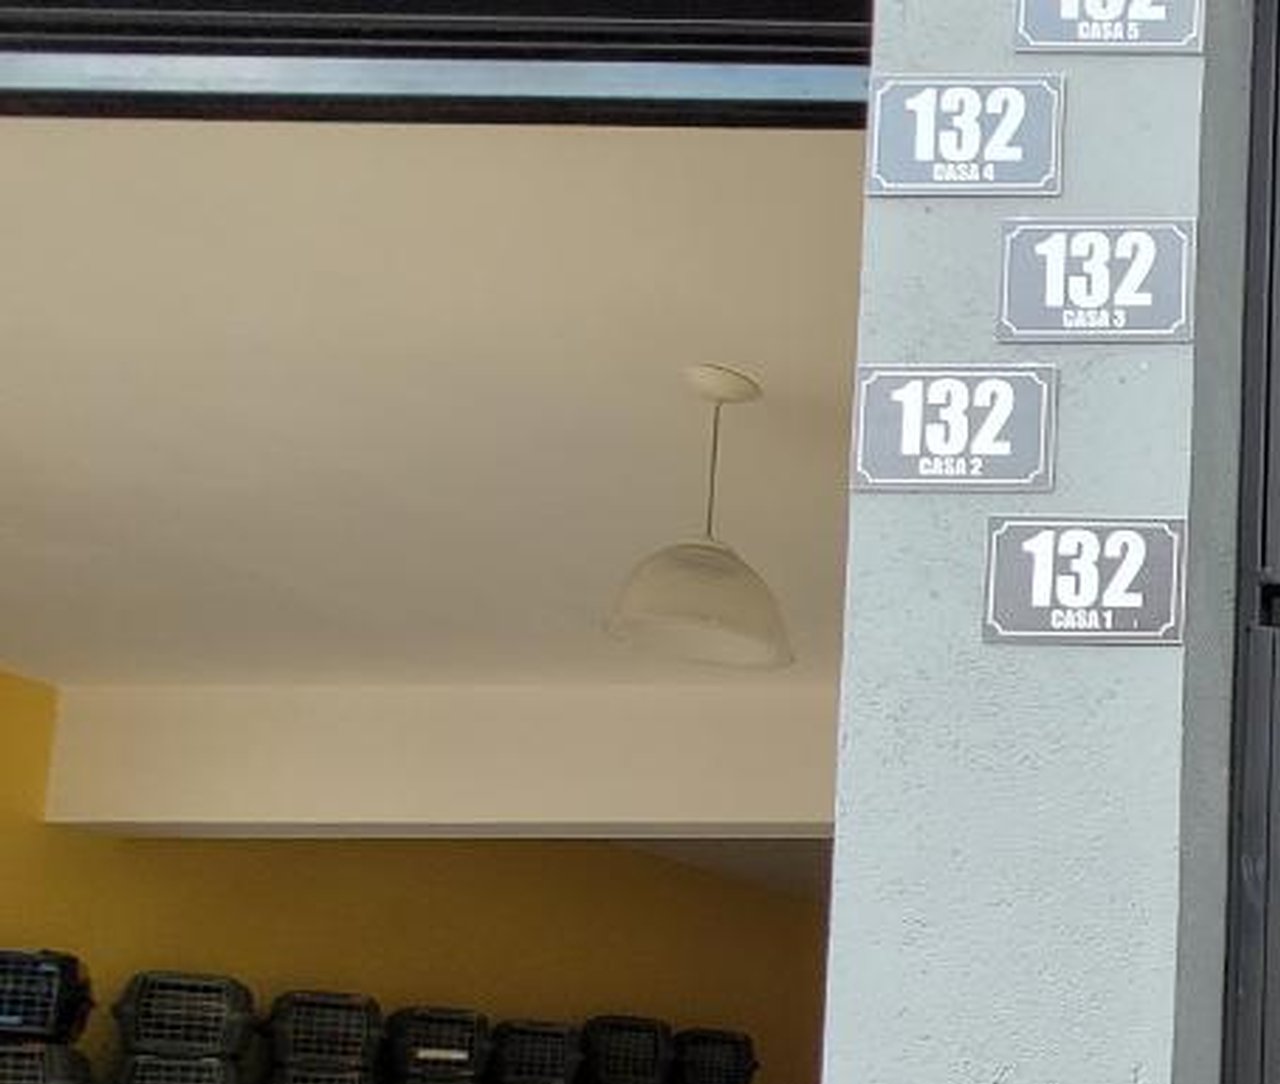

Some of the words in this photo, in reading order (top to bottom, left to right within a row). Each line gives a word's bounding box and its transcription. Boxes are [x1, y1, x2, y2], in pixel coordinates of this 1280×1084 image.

[1078, 22, 1124, 39] CASA
[1128, 23, 1140, 39] 5
[905, 86, 1026, 163] 132
[933, 162, 979, 182] CASA
[980, 162, 995, 181] 4
[1035, 231, 1157, 308] 132
[1062, 308, 1110, 328] CASA
[1111, 309, 1126, 328] 3
[891, 377, 1015, 457] 132
[918, 456, 964, 476] CASA
[965, 457, 984, 476] 2
[1022, 529, 1147, 609] 132
[1051, 608, 1100, 629] CASA
[1102, 609, 1113, 629] 1
